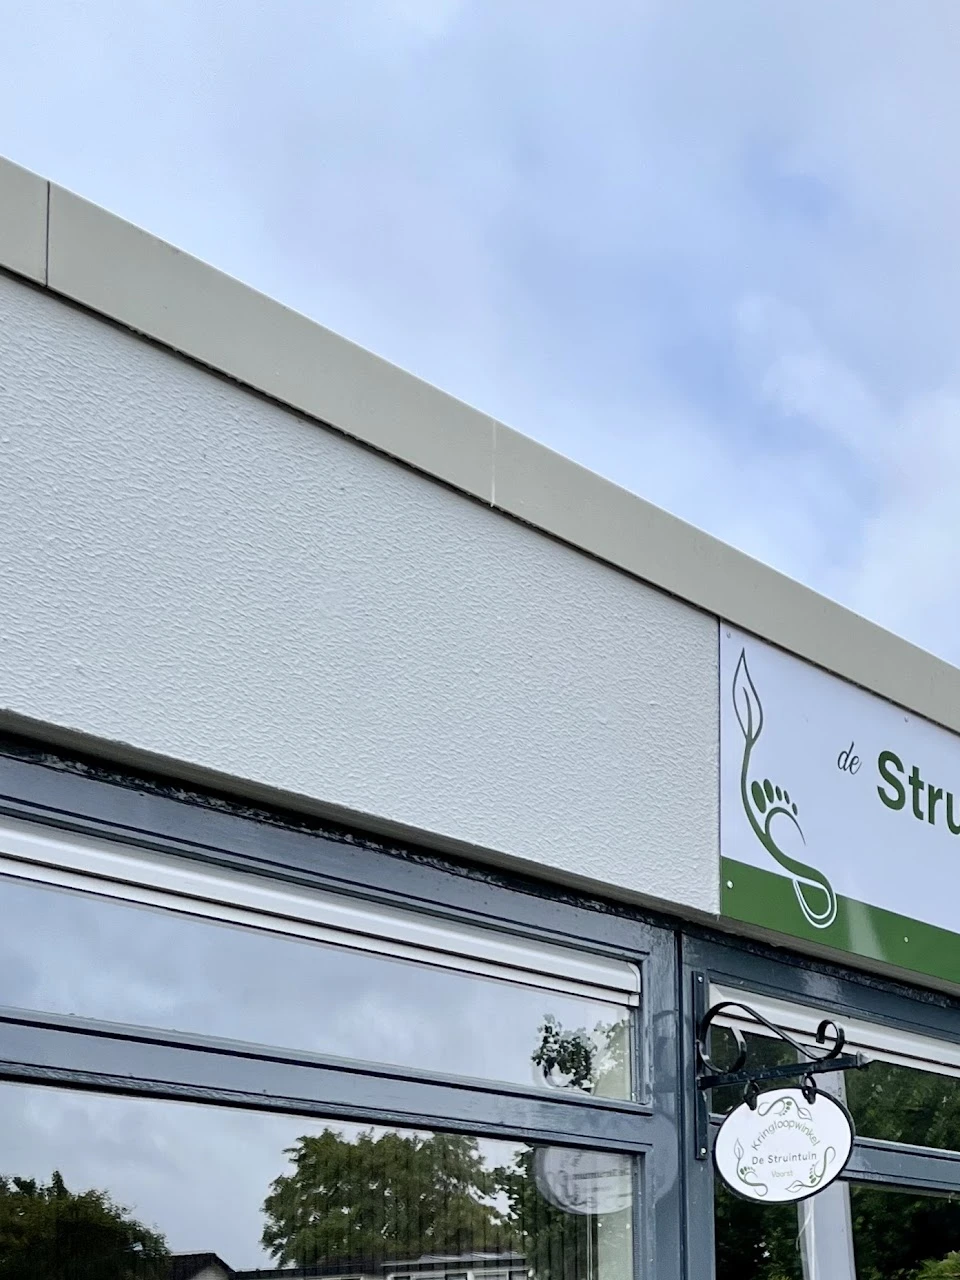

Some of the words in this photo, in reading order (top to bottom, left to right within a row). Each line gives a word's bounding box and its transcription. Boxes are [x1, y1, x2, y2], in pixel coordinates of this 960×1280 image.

[837, 741, 863, 776] de
[751, 1119, 820, 1151] Kringloopwinkel
[751, 1156, 765, 1165] De
[767, 1151, 817, 1164] Struintuin
[771, 1170, 794, 1178] Voorst
